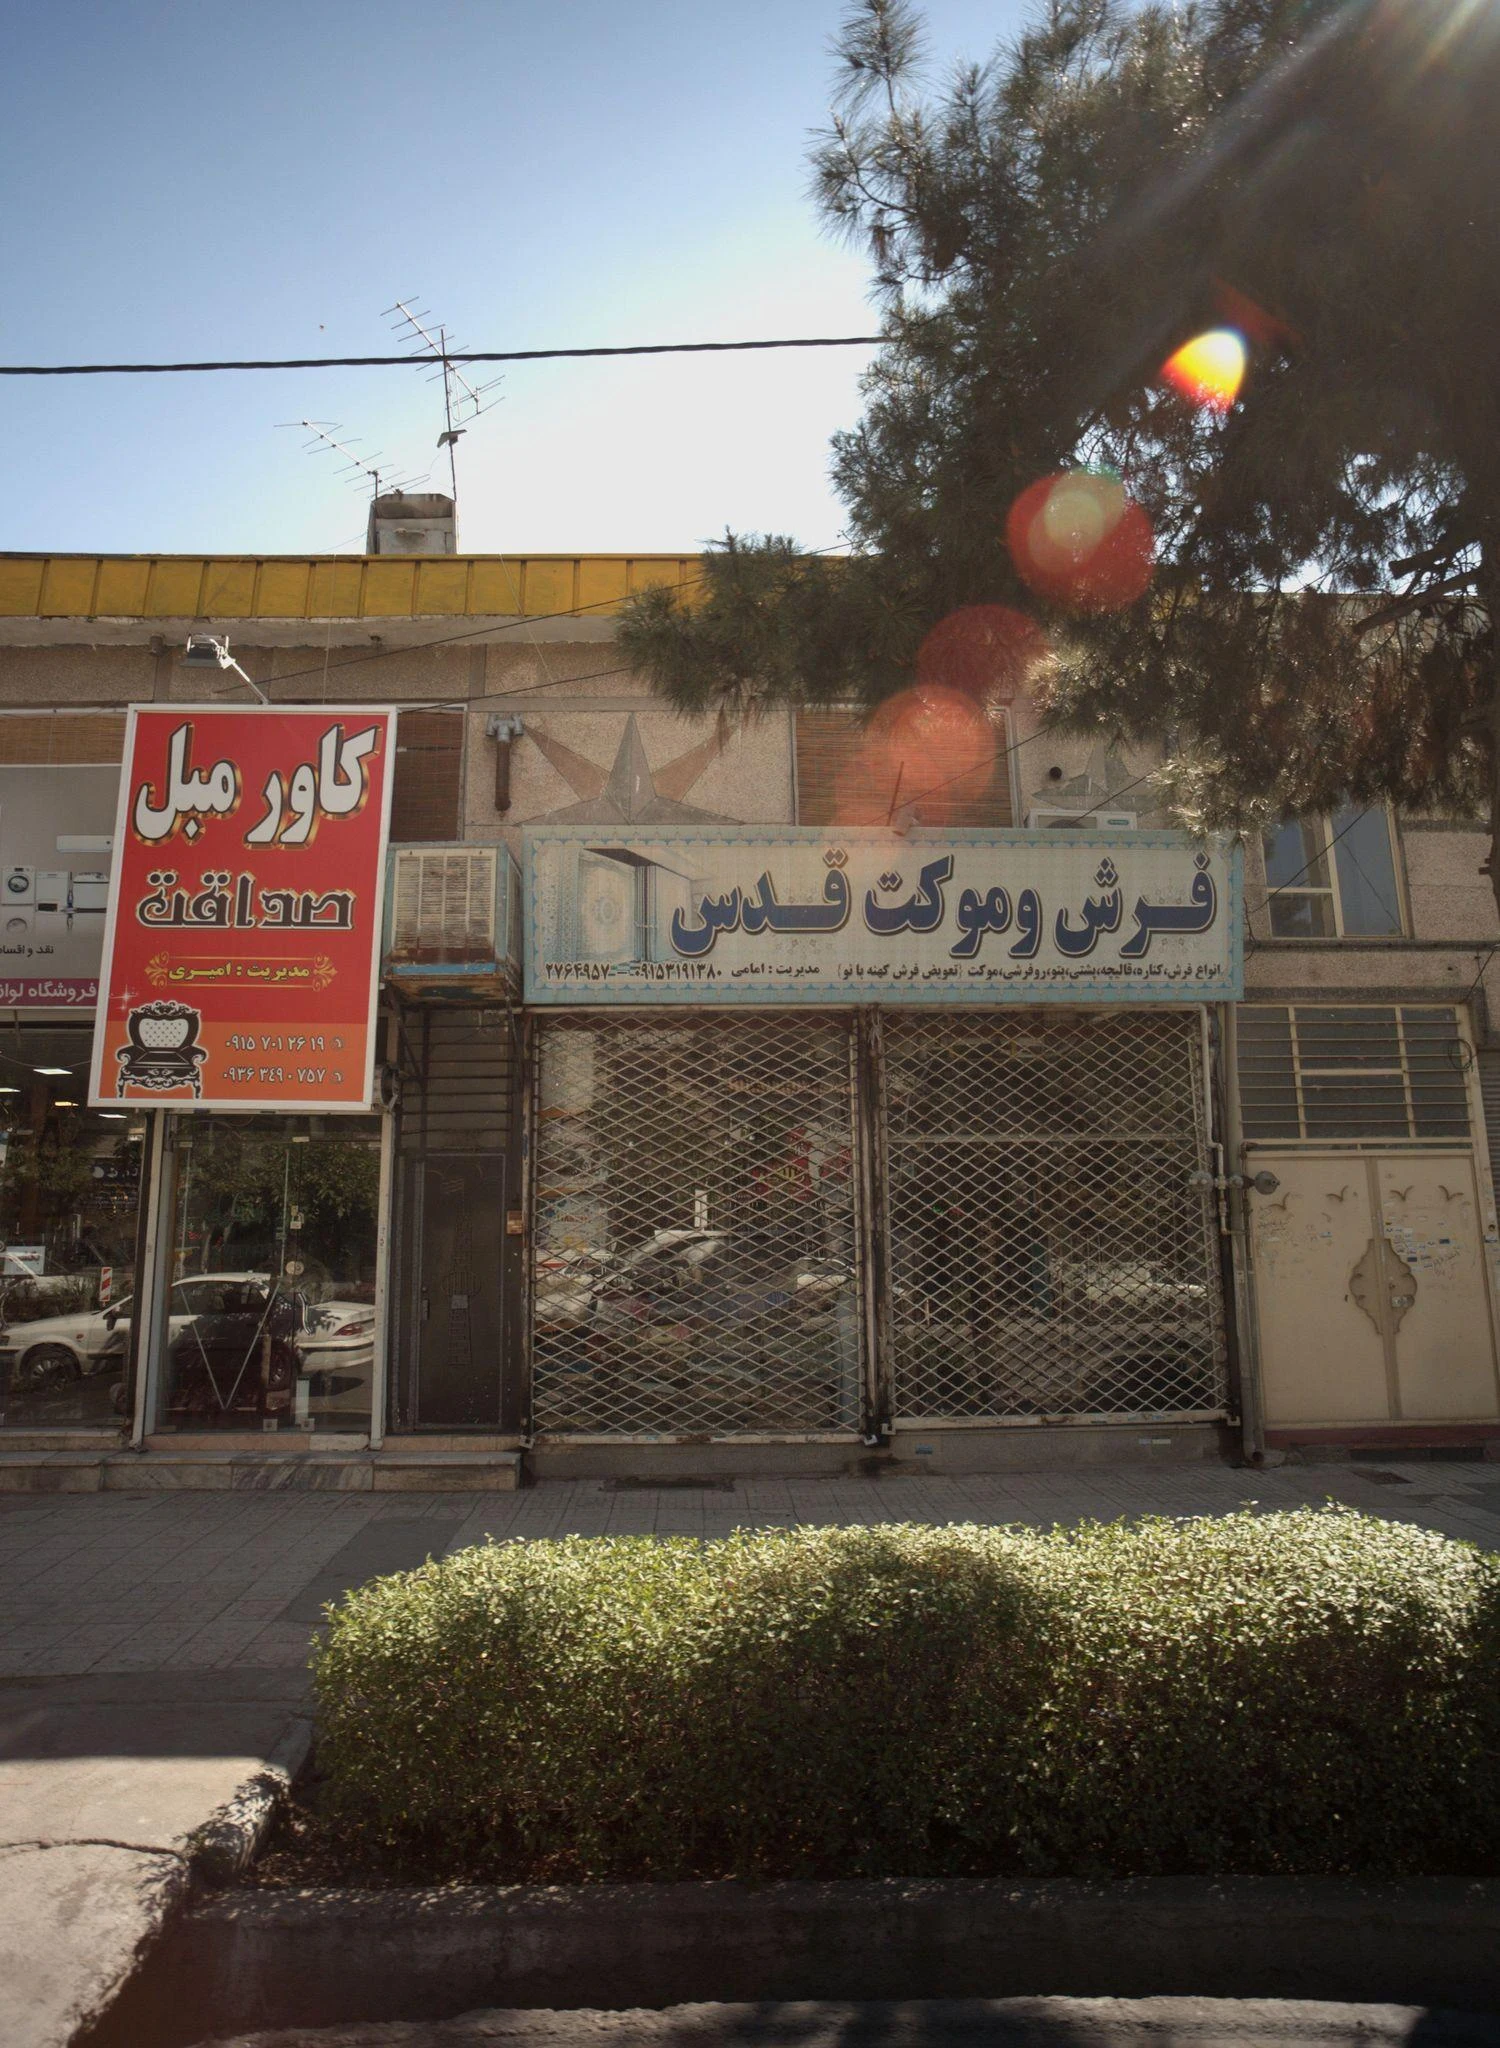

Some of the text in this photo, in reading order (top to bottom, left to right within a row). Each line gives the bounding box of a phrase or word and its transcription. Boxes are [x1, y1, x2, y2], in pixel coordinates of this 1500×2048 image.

[132, 721, 383, 850] کاور مبل
[136, 868, 356, 930] صداقت
[670, 847, 851, 956] قدس
[1054, 852, 1218, 959] فرش
[36, 944, 54, 954] نقد
[168, 960, 233, 980] امیری
[246, 963, 310, 981] مدیریت
[731, 963, 765, 978] امامی
[775, 965, 820, 978] مدیریت
[856, 963, 864, 980] با
[867, 964, 889, 980] کهنه
[892, 964, 919, 981] فرش
[1195, 963, 1221, 980] انواع
[28, 980, 97, 1003] فروشگاه
